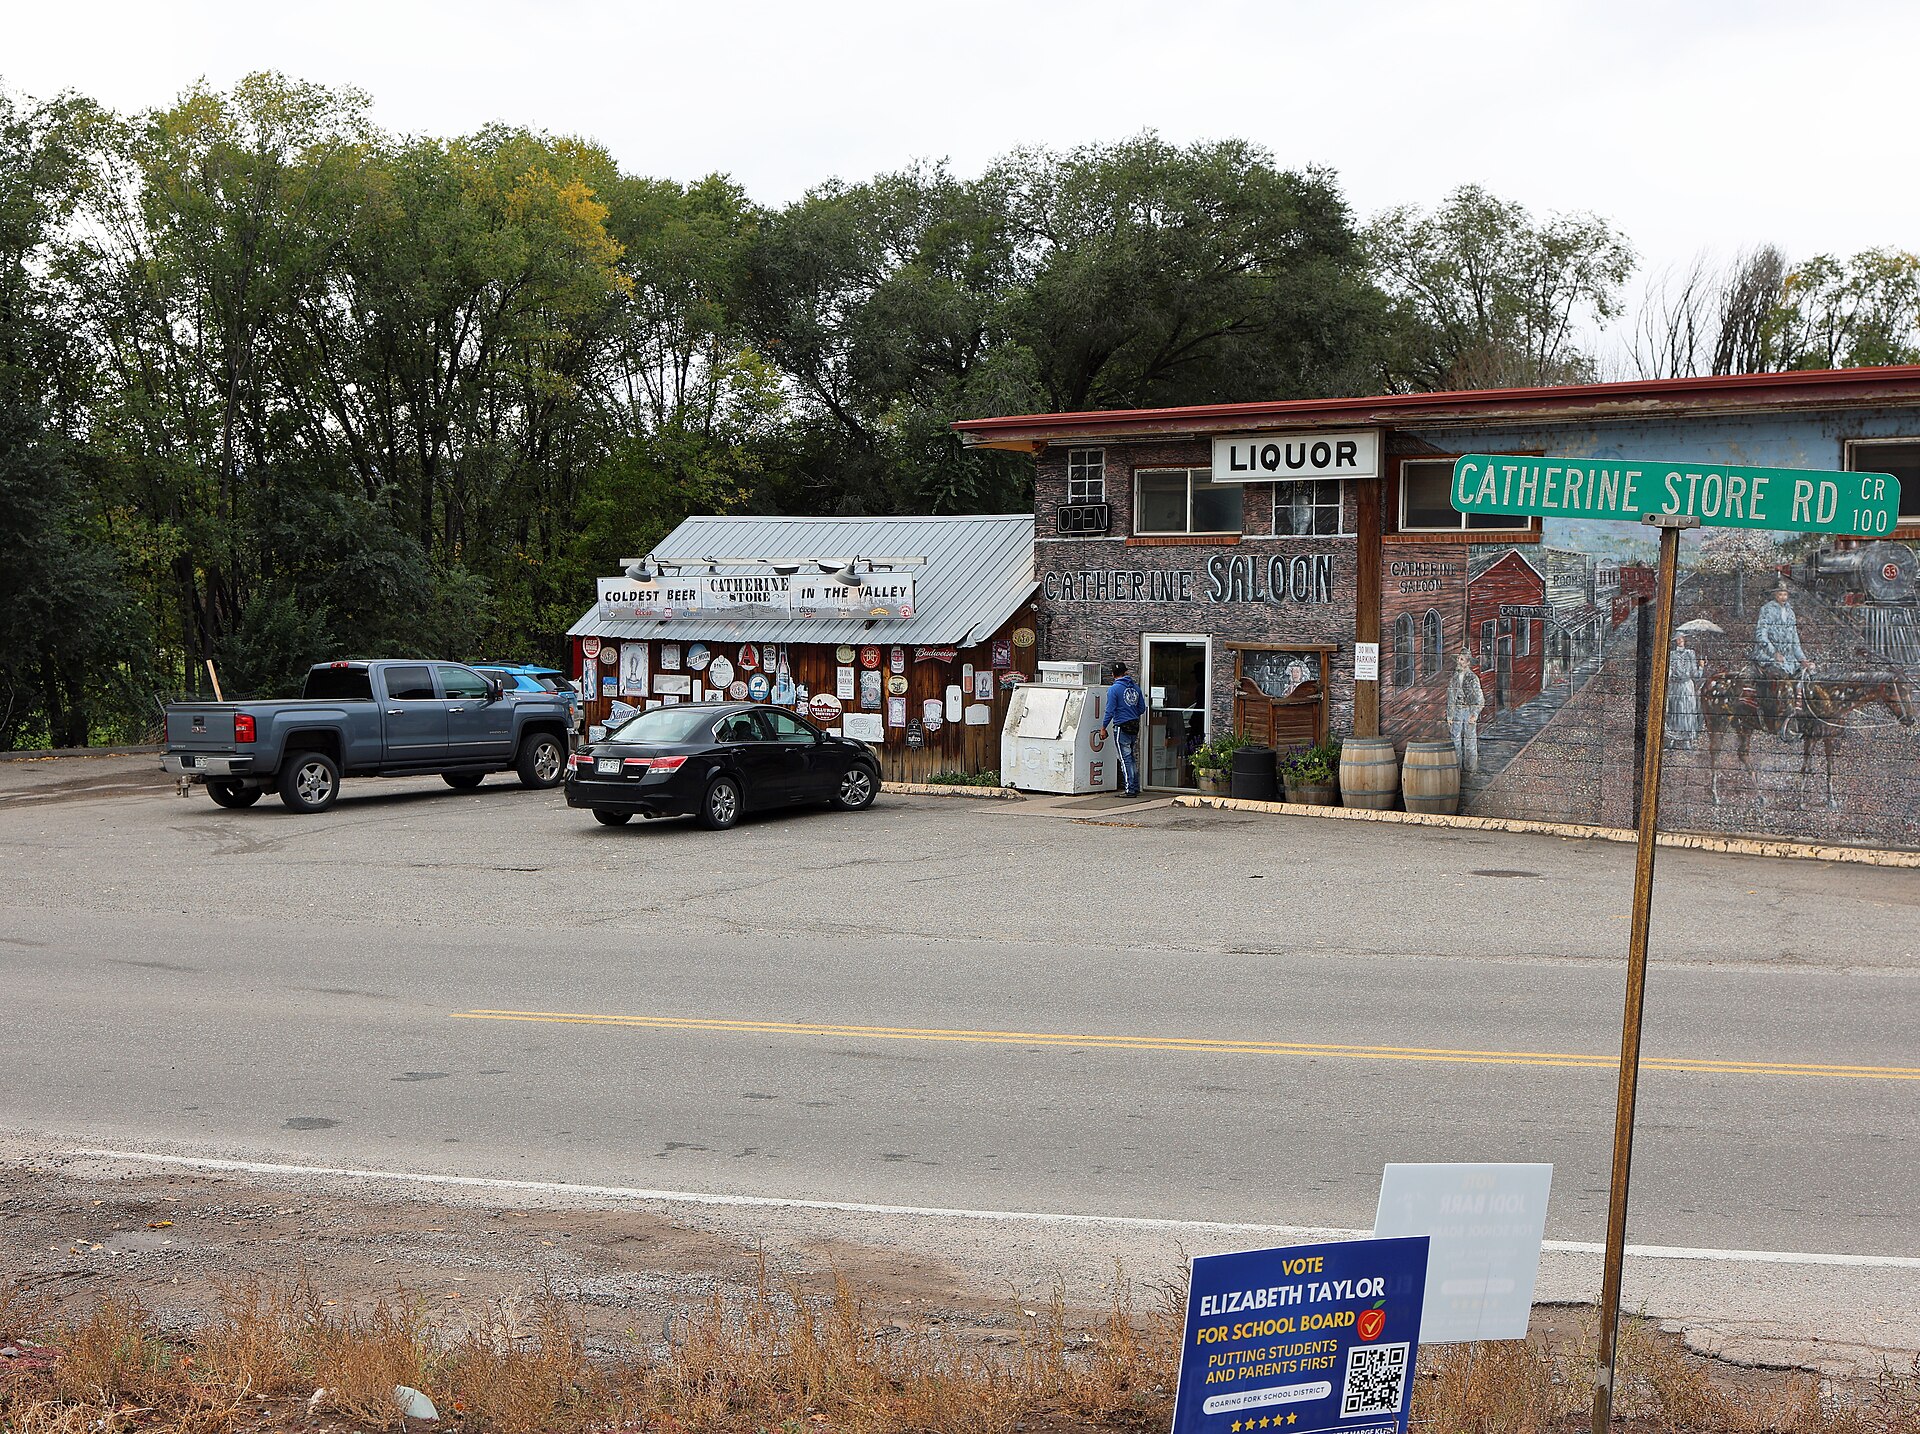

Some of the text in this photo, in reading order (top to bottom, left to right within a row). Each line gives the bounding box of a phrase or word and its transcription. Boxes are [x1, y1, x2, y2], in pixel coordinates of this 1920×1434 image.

[1230, 440, 1358, 472] LIQUOR
[1457, 462, 1839, 525] CATHERINE STORE RD
[1861, 477, 1885, 501] CR
[1060, 506, 1106, 531] OPEN
[1852, 508, 1887, 533] 100
[1043, 554, 1335, 604] CATHERINE SALOON
[1390, 561, 1457, 577] CATHERINE
[1553, 574, 1585, 587] ROOMS
[605, 589, 696, 603] COLDEST BEER
[710, 577, 789, 592] CATHERINE
[801, 586, 908, 600] IN THE VALLEY
[1400, 579, 1444, 594] SALOON
[729, 592, 771, 603] STORE
[914, 647, 958, 657] Budweiser
[610, 705, 640, 720] Natural
[1090, 695, 1105, 786] ICE
[1282, 1256, 1324, 1277] VOTE
[1200, 1277, 1385, 1317] ELIZABETH TAYLOR
[1197, 1311, 1355, 1345] FOR SCHOOL BOARD
[1208, 1339, 1338, 1368] PUTTING STUDENTS
[1205, 1355, 1336, 1385] AND PARENTS FIRST
[1210, 1386, 1325, 1409] ROARING FORK SCHOOL DISTRICT
